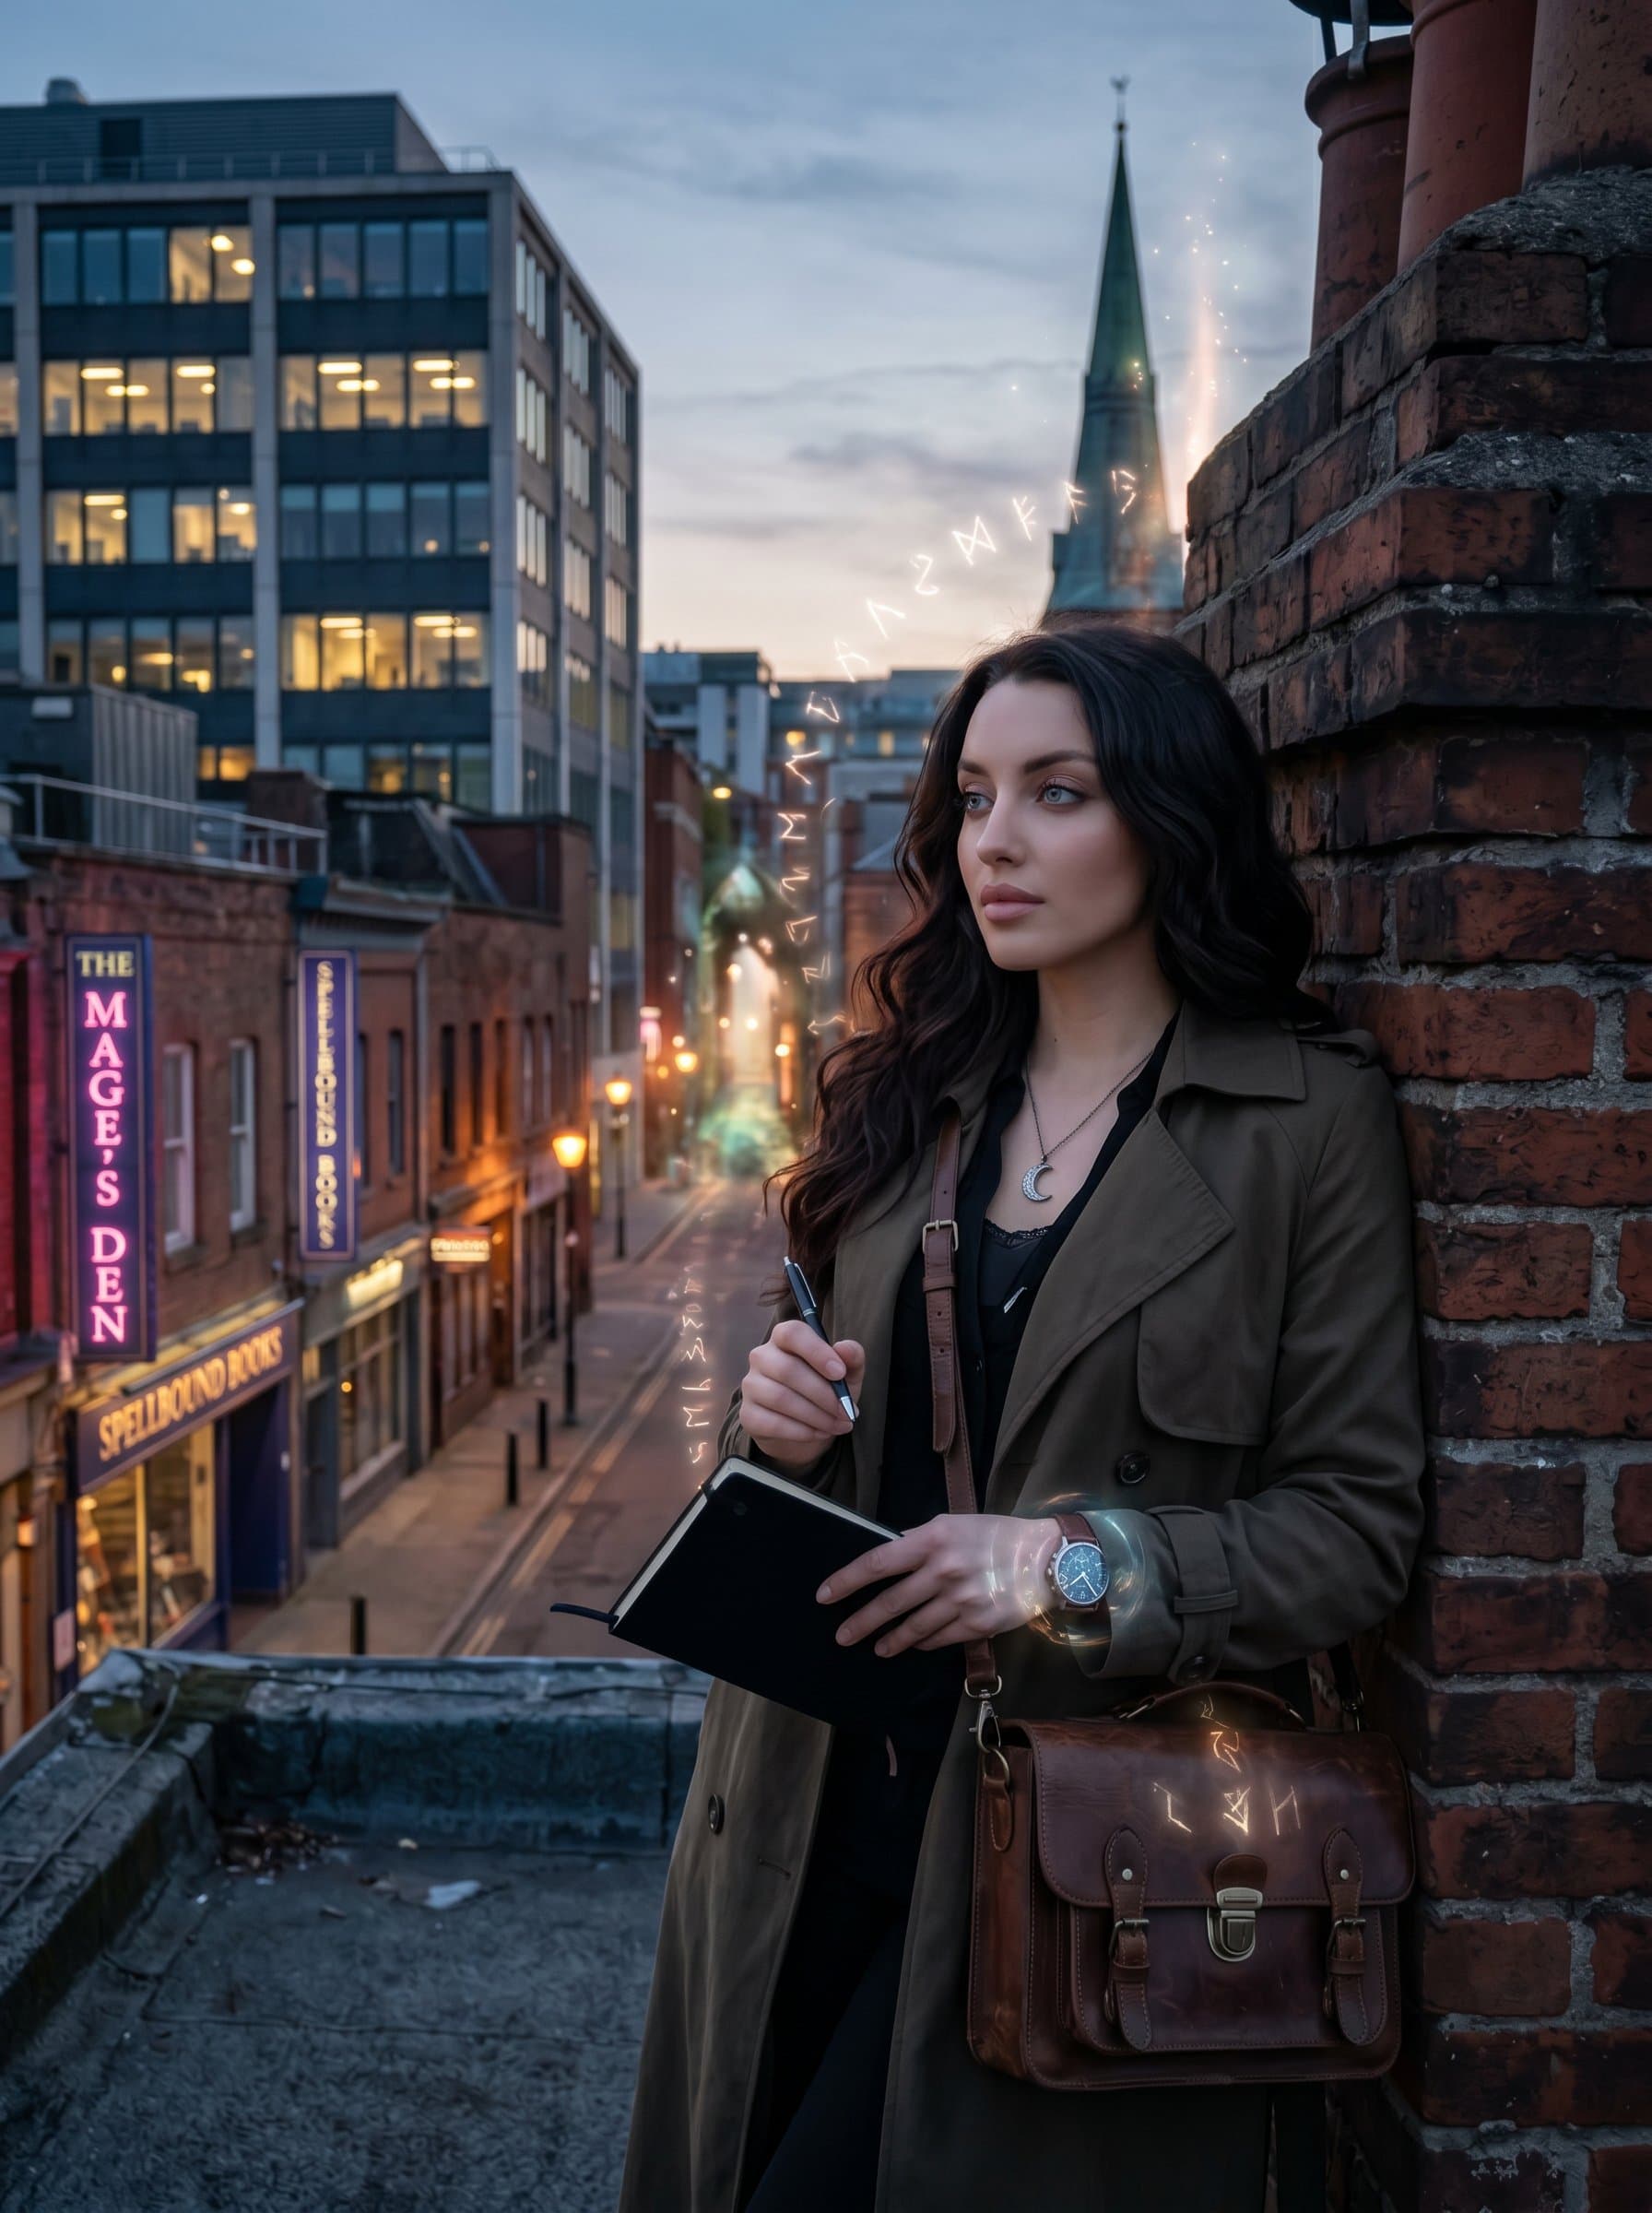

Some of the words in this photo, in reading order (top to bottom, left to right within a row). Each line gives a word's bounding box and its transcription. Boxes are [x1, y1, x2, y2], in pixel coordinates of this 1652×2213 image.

[76, 951, 135, 977] THE
[84, 990, 127, 1207] MAGE'S
[90, 1226, 127, 1343] DEN
[99, 1357, 226, 1462] SPELLBOUND
[227, 1326, 283, 1391] BOOKS
